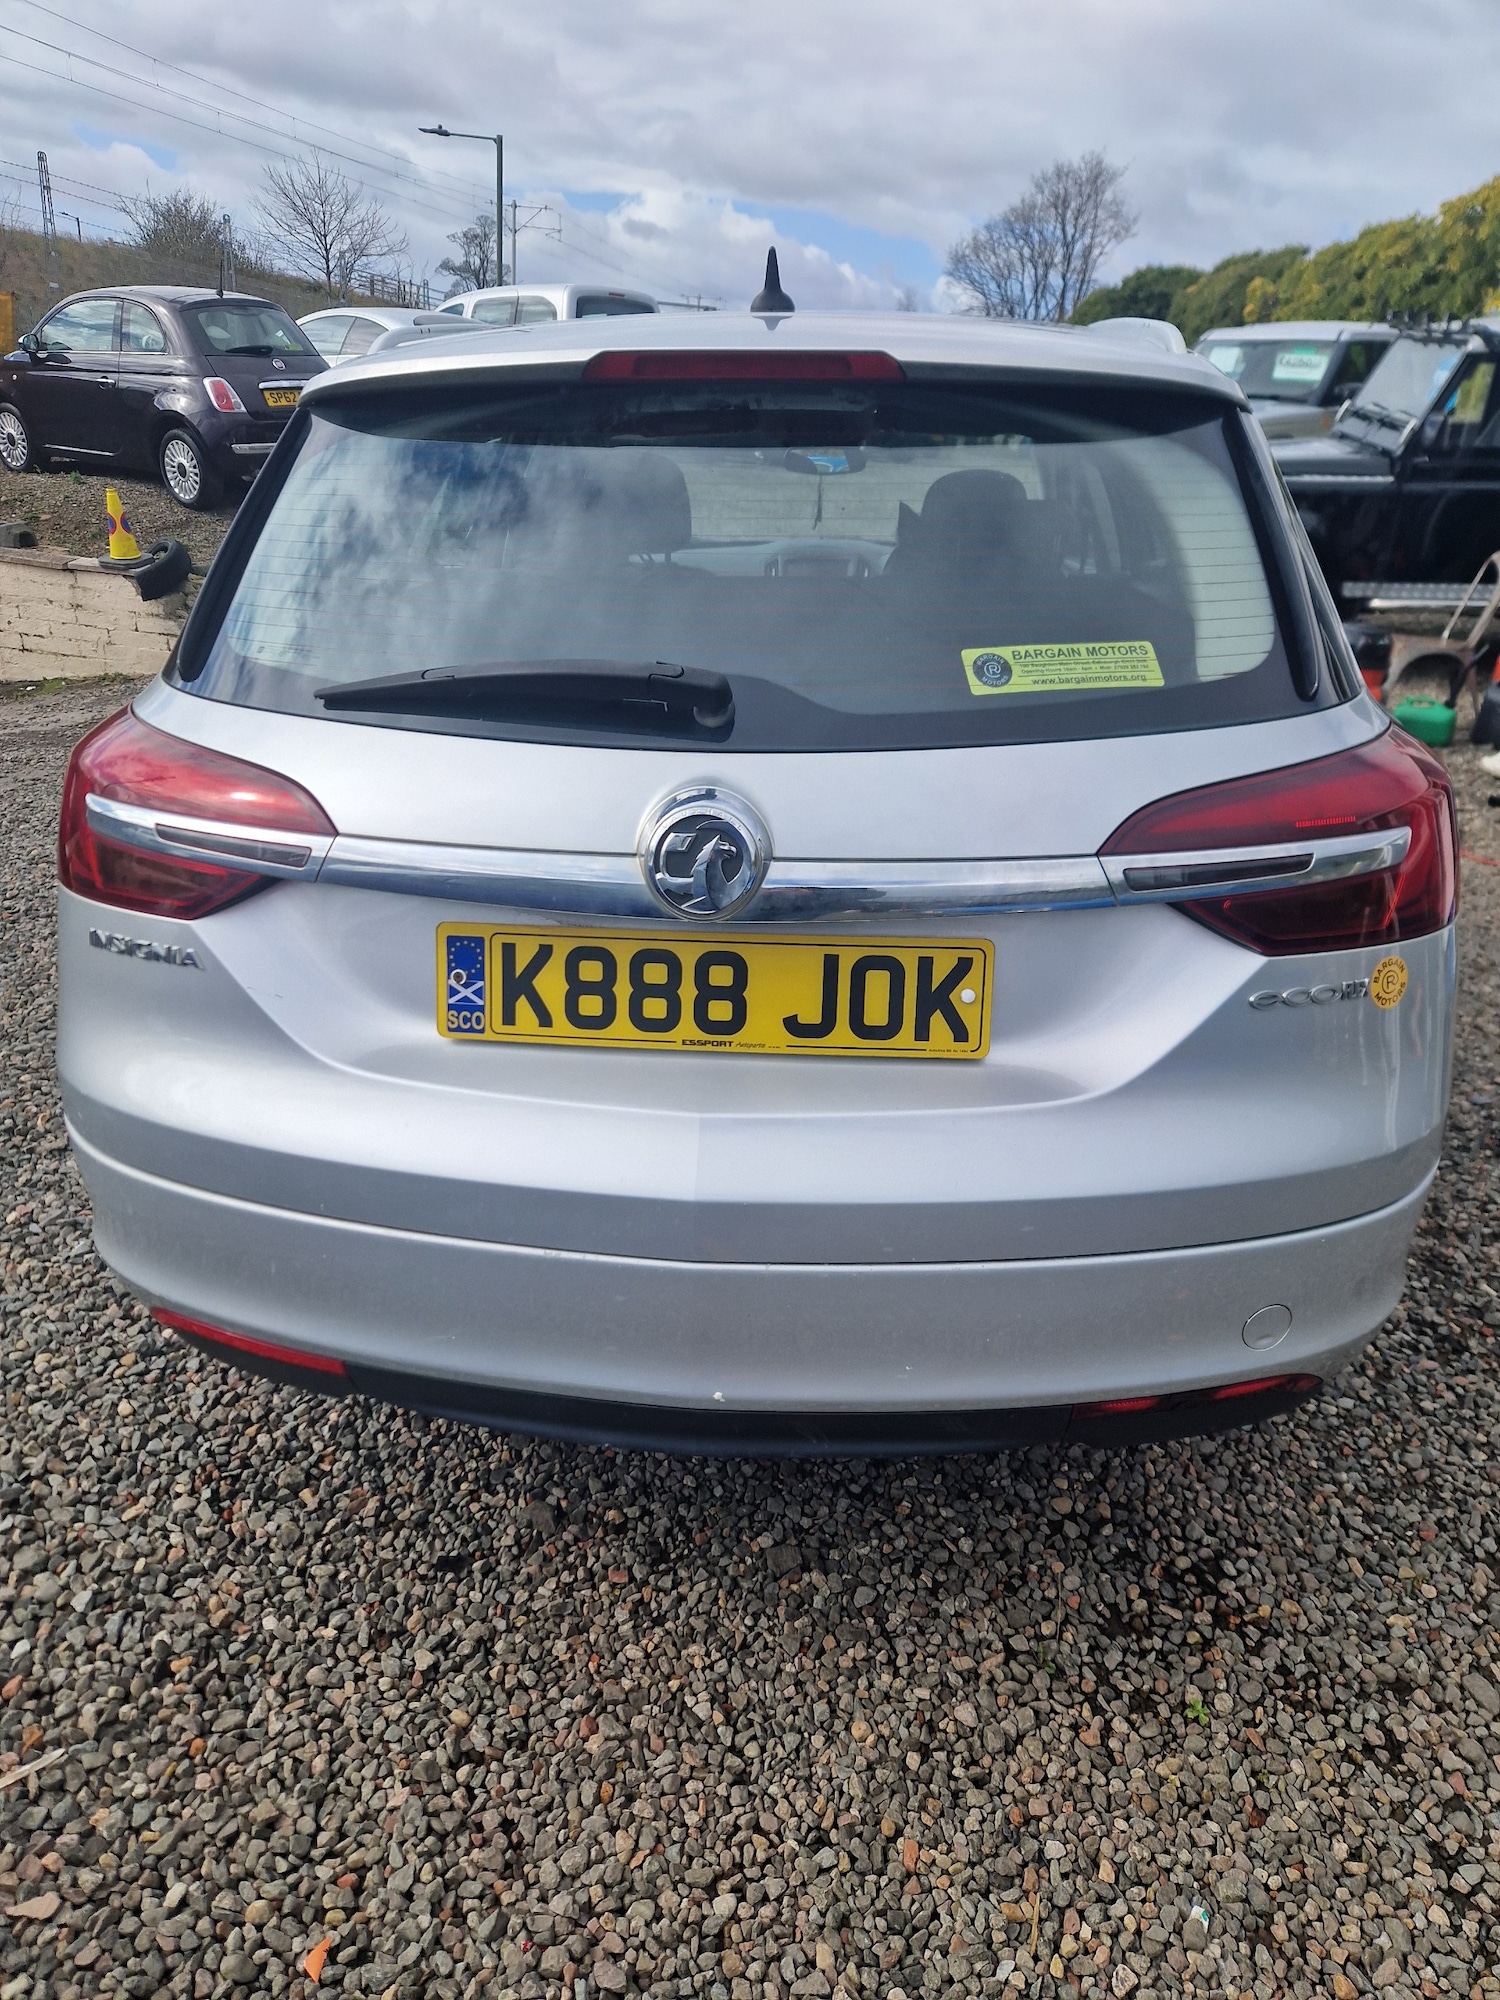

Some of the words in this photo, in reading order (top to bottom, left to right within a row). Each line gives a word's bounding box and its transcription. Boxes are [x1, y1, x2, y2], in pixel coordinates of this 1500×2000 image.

[269, 391, 297, 404] SP62
[976, 654, 1006, 666] BARGAIN
[1012, 648, 1082, 661] BARGAIN
[1086, 645, 1148, 657] MOTORS
[981, 675, 1009, 686] MOTORS
[1031, 674, 1147, 685] www.bargainmotors.org
[1373, 958, 1406, 983] BARGAIN
[501, 942, 748, 1036] K888
[783, 953, 974, 1043] JOK
[1374, 982, 1406, 1006] MOTORS
[447, 1009, 485, 1031] SCO
[681, 1039, 734, 1048] ESSPORT
